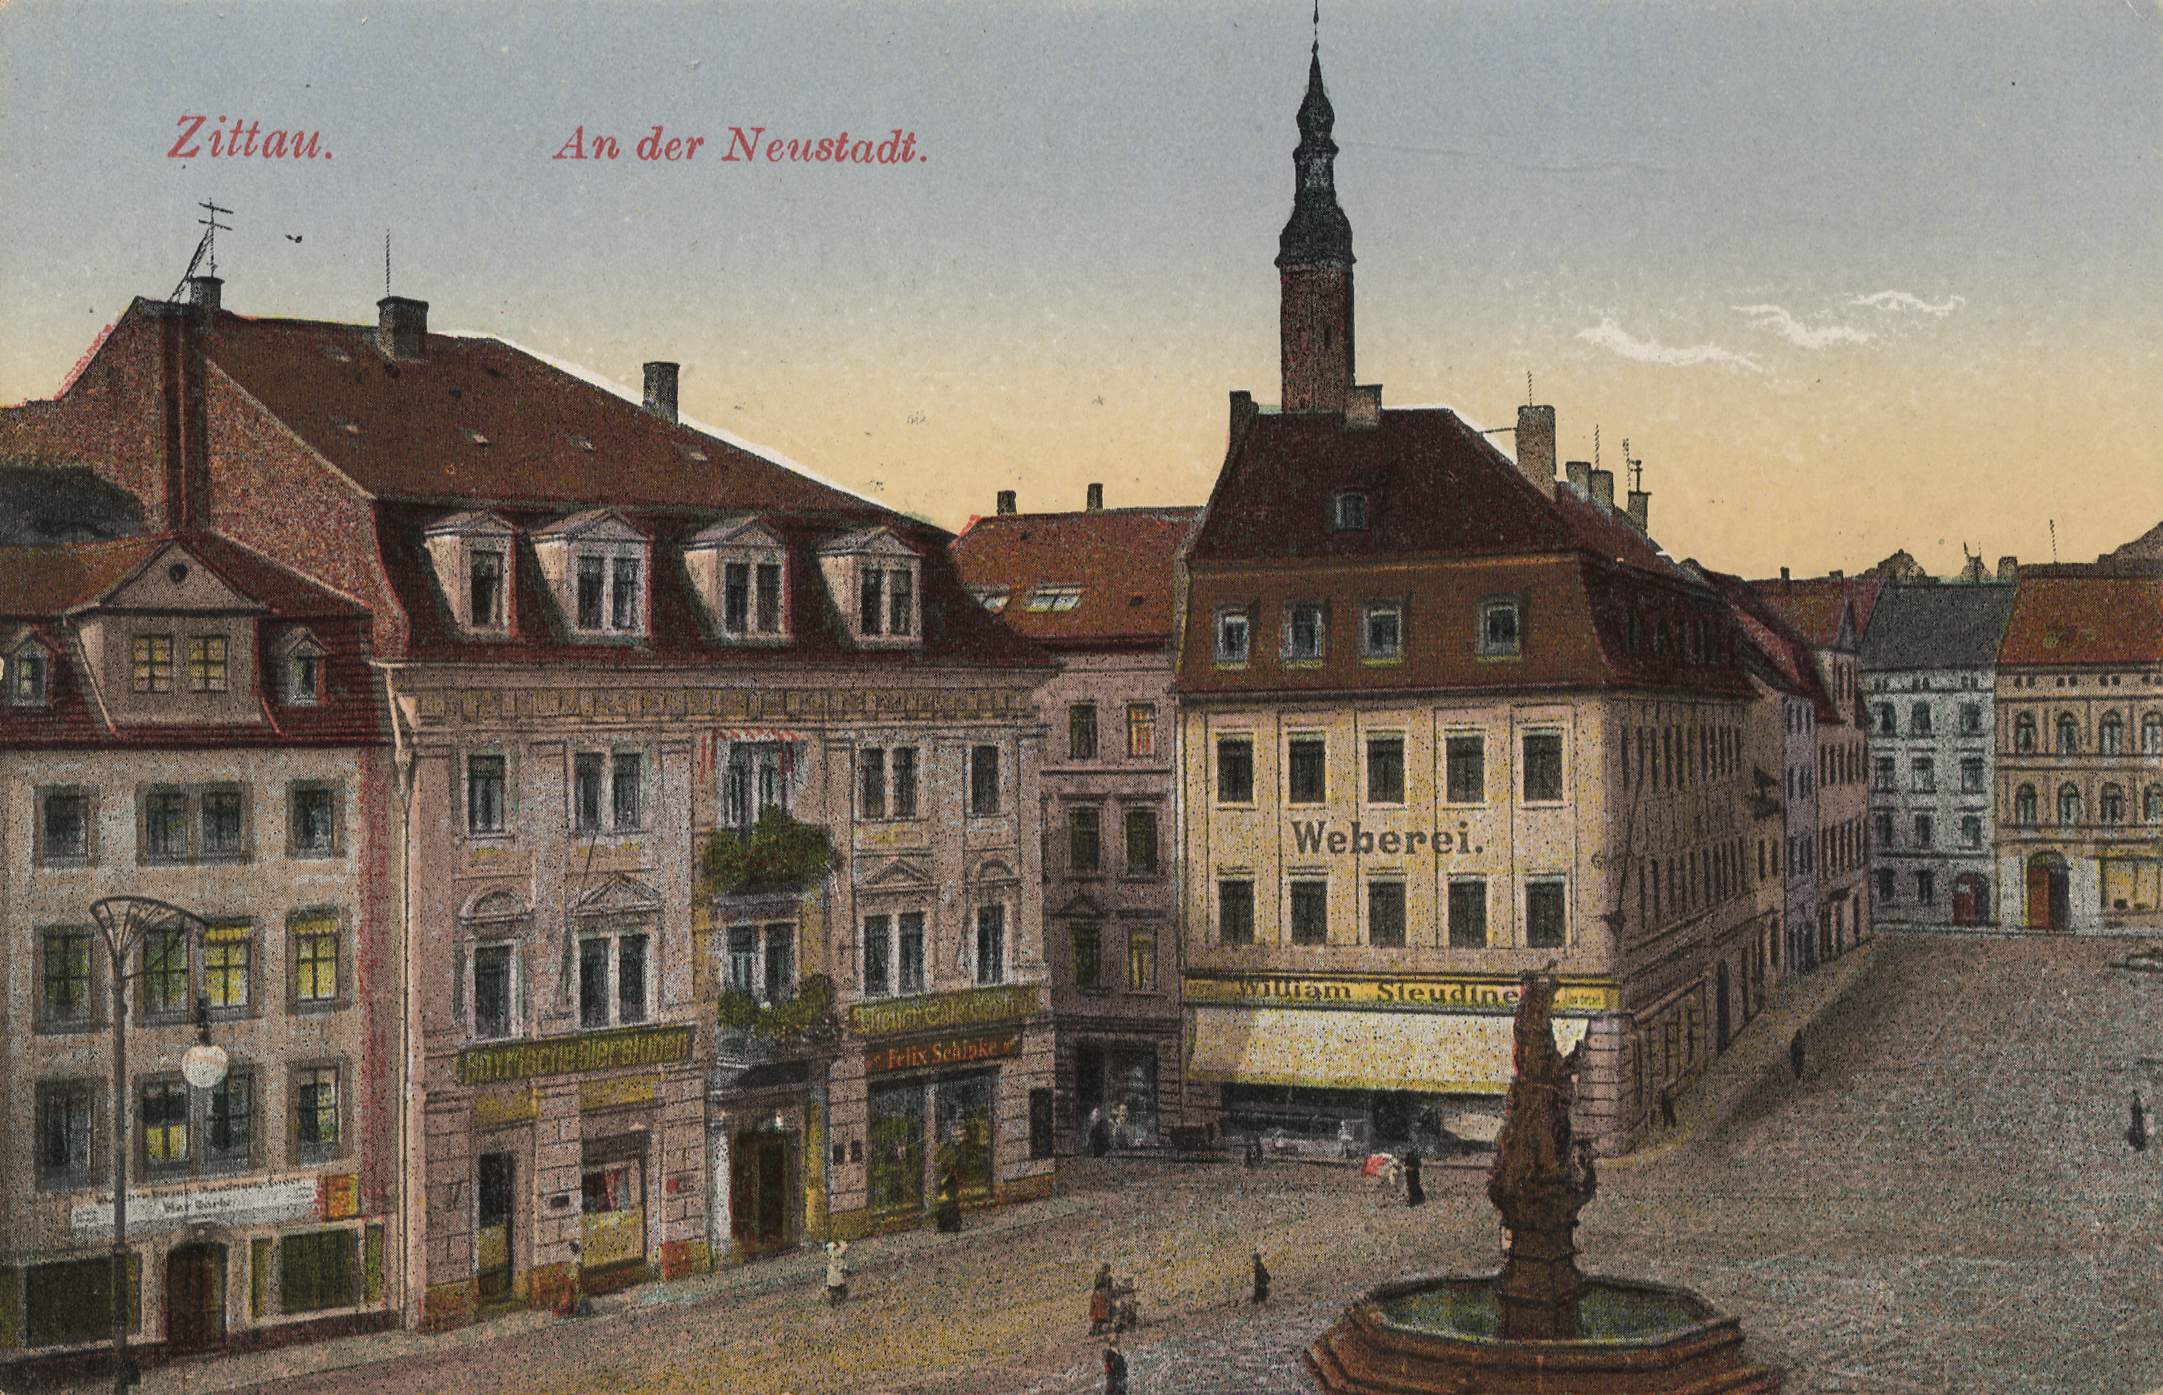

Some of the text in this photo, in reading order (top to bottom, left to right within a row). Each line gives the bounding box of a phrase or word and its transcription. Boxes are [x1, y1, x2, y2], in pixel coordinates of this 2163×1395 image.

[1290, 821, 1484, 855] Weberei.
[1238, 978, 1351, 1001] William
[888, 1045, 928, 1069] Felix
